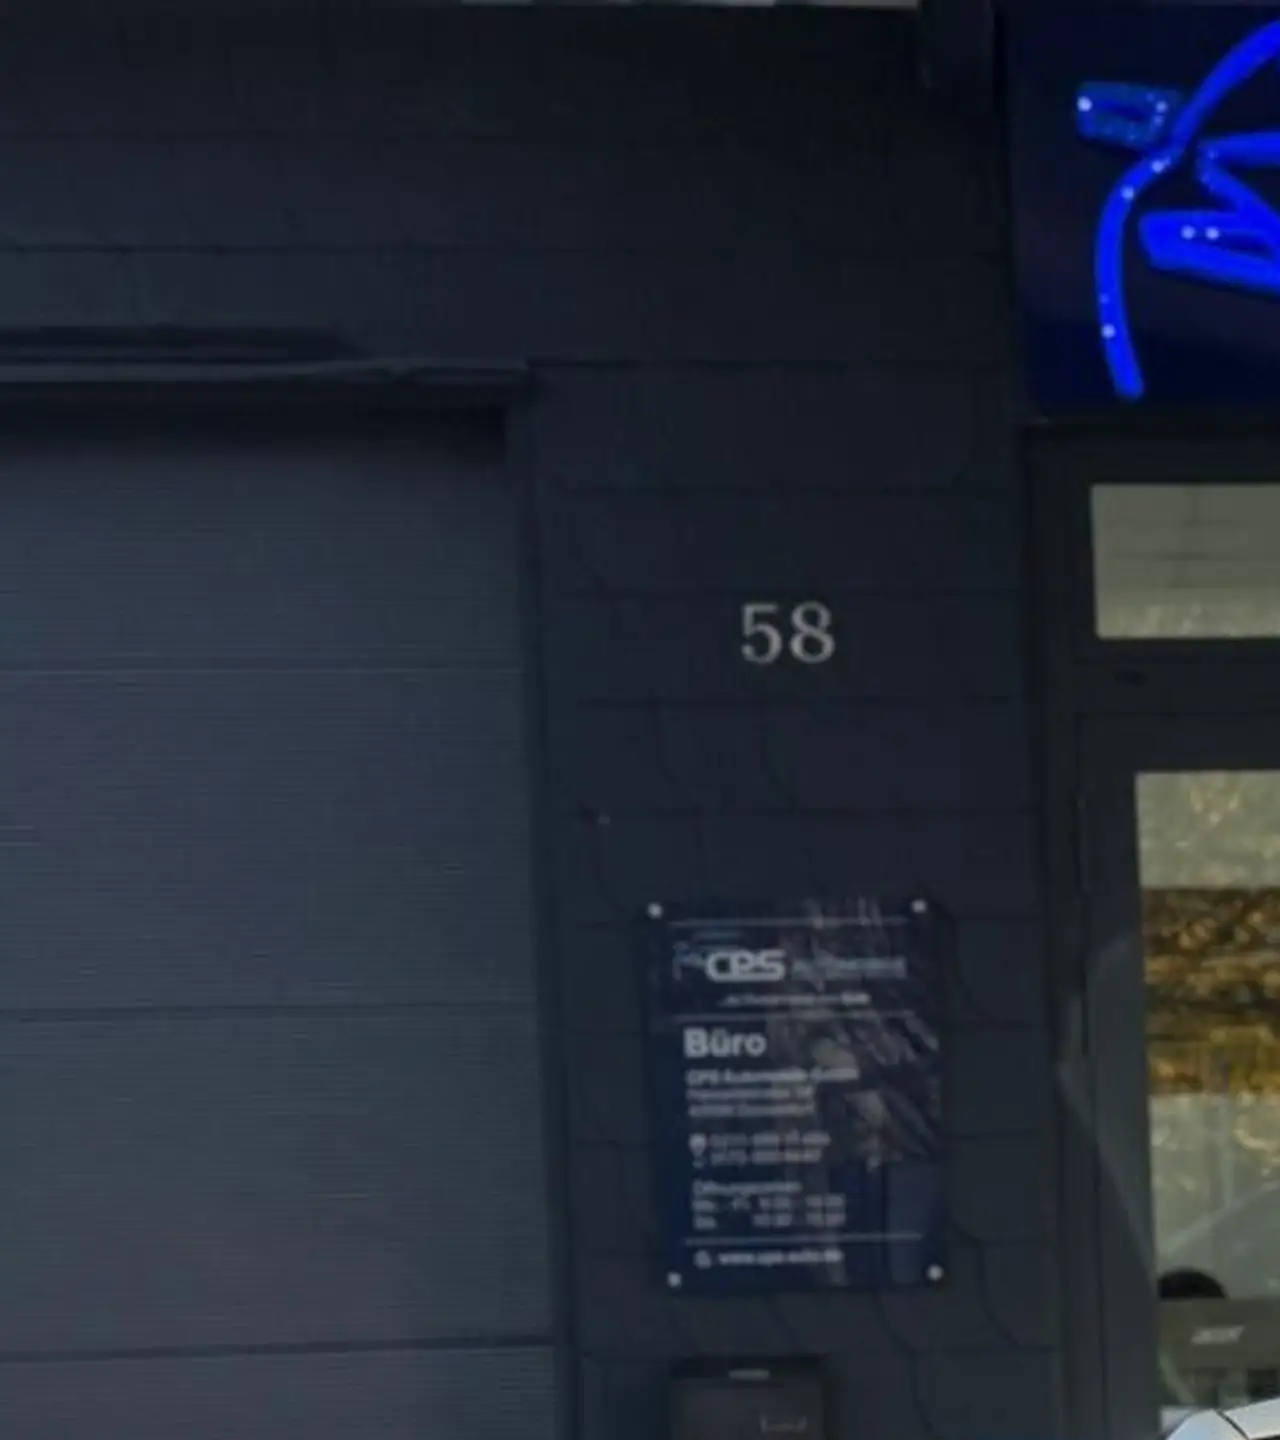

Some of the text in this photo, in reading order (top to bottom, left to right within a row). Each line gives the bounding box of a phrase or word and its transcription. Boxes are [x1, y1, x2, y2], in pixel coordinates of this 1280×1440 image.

[740, 601, 836, 665] 58
[706, 948, 786, 982] CPS
[684, 1026, 768, 1058] Büro
